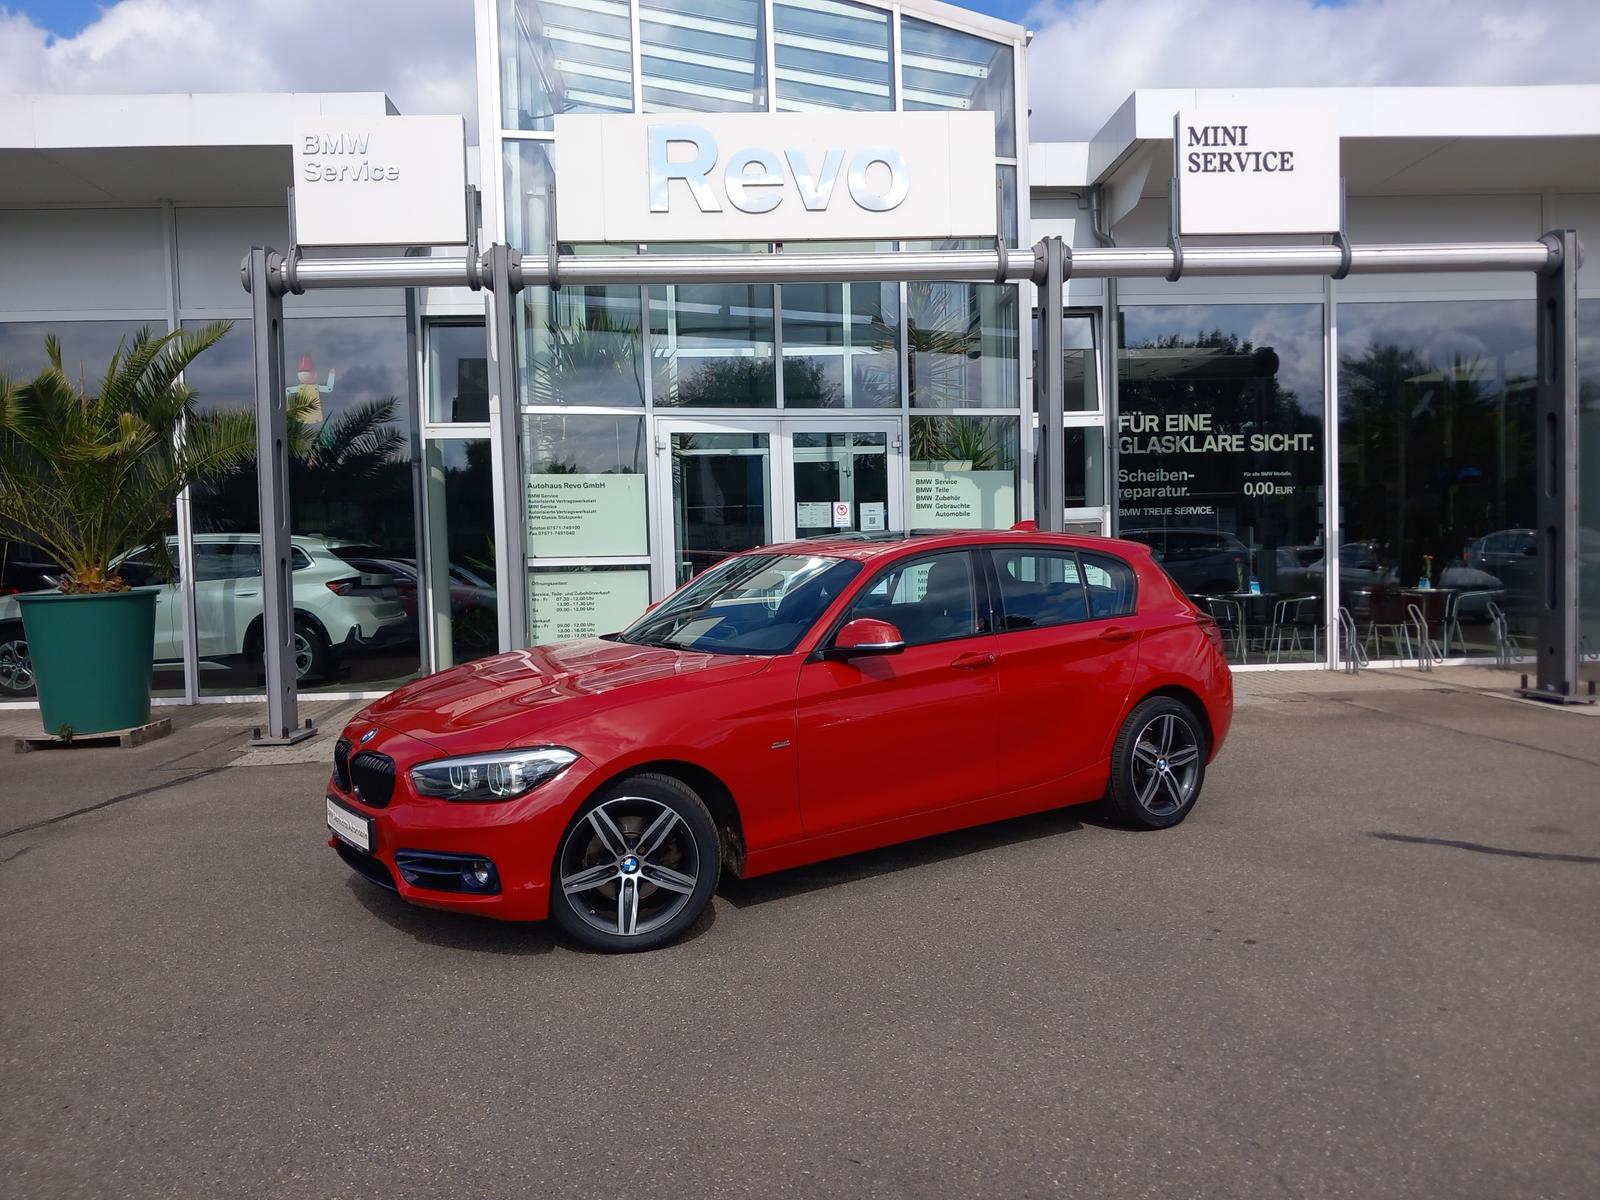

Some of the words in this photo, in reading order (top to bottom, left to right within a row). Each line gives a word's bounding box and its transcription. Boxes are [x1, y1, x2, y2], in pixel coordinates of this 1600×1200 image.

[302, 132, 370, 155] BMW
[1187, 126, 1248, 147] MINI
[304, 160, 400, 182] Service
[647, 124, 911, 214] Revo
[1188, 151, 1294, 173] SERVICE
[1118, 411, 1158, 433] FÜR
[1166, 413, 1212, 431] EINE
[1118, 434, 1245, 454] GLASKLARE
[1250, 433, 1315, 452] SICHT.
[1118, 468, 1195, 482] Scheiben-
[1118, 485, 1191, 500] reparatur.
[1243, 481, 1274, 498] 0,00
[1118, 507, 1141, 517] BMW
[1143, 507, 1173, 516] TREUE
[1174, 506, 1215, 515] SERVICE.
